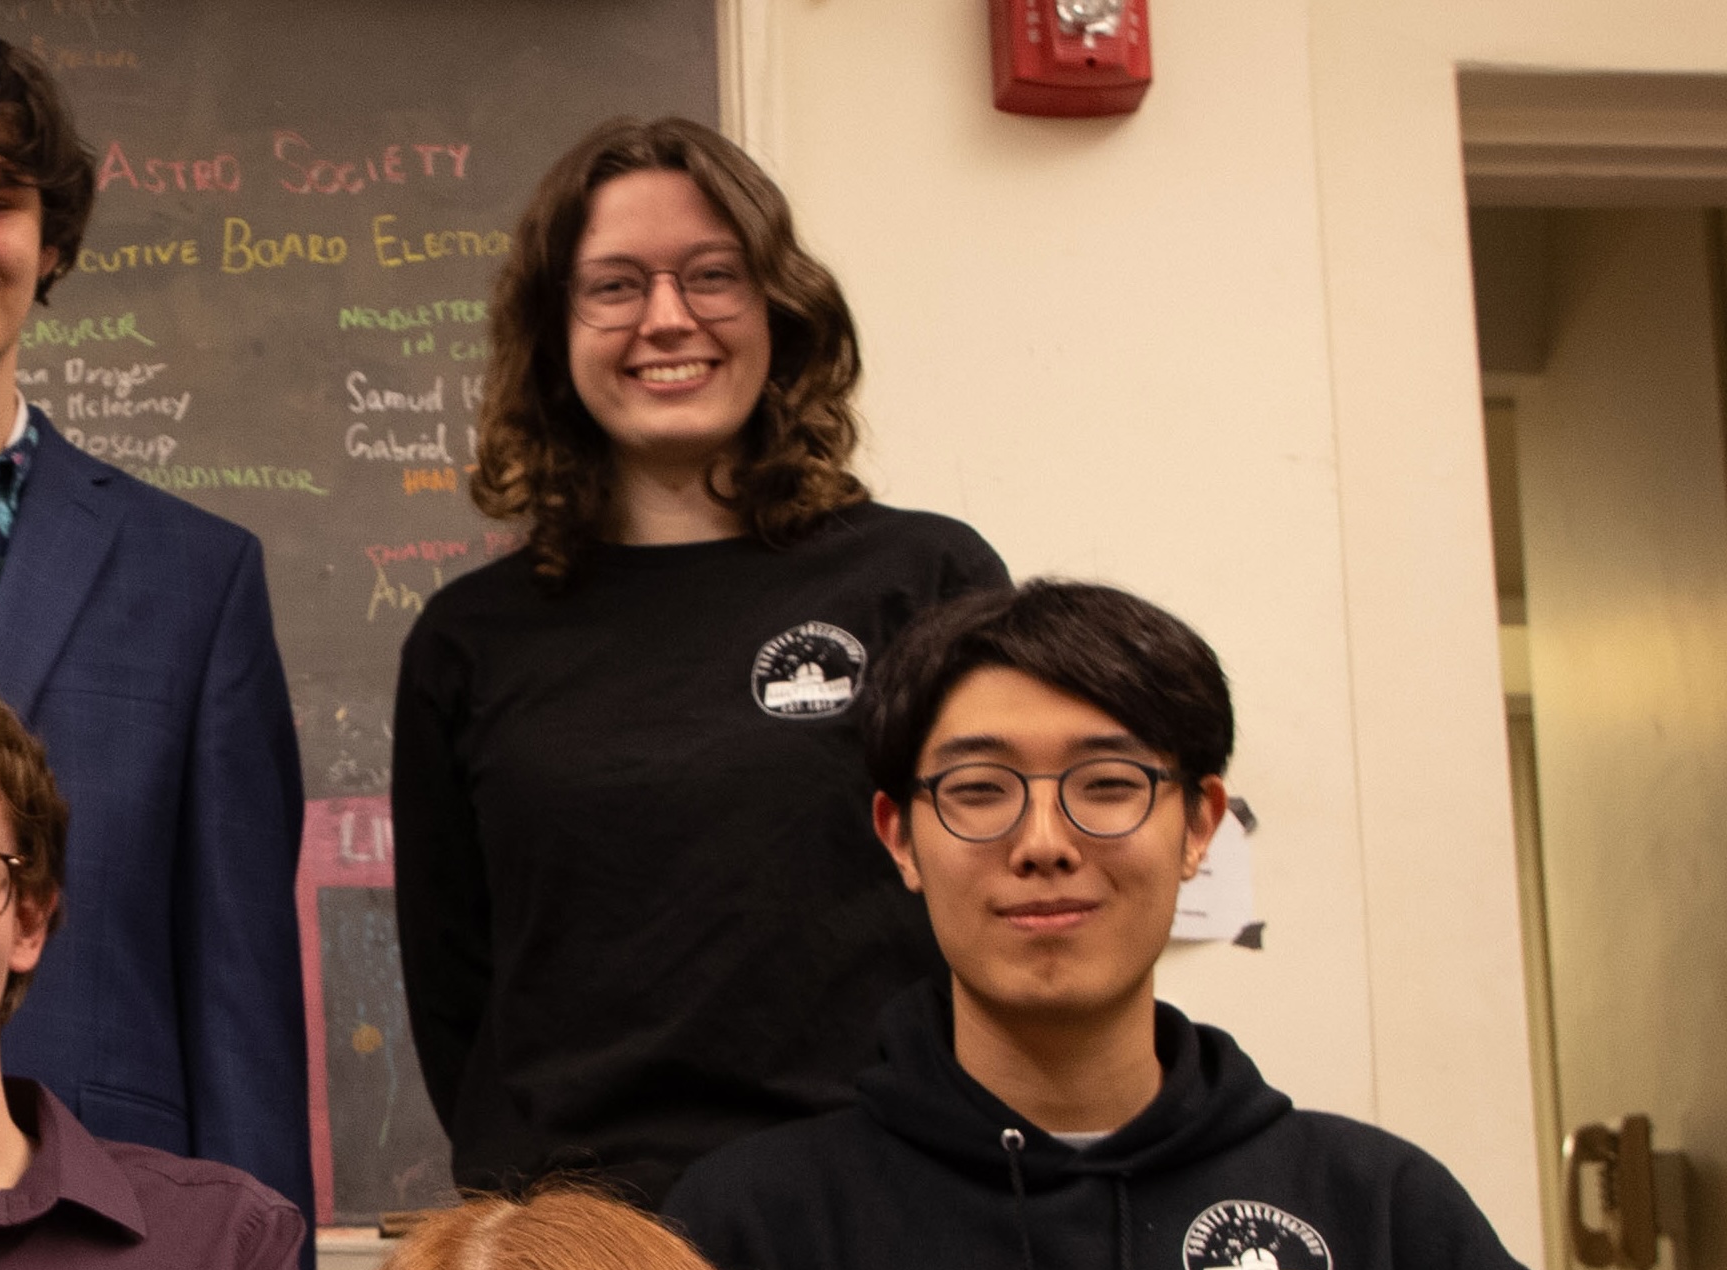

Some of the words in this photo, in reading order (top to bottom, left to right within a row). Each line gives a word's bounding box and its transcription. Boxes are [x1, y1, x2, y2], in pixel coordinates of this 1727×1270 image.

[98, 142, 242, 194] ASTRO
[274, 130, 470, 194] SOCIETY
[77, 239, 201, 273] CUTIVE
[221, 216, 348, 275] BOARD
[373, 214, 513, 269] ELECTIO
[21, 312, 156, 348] EASURER
